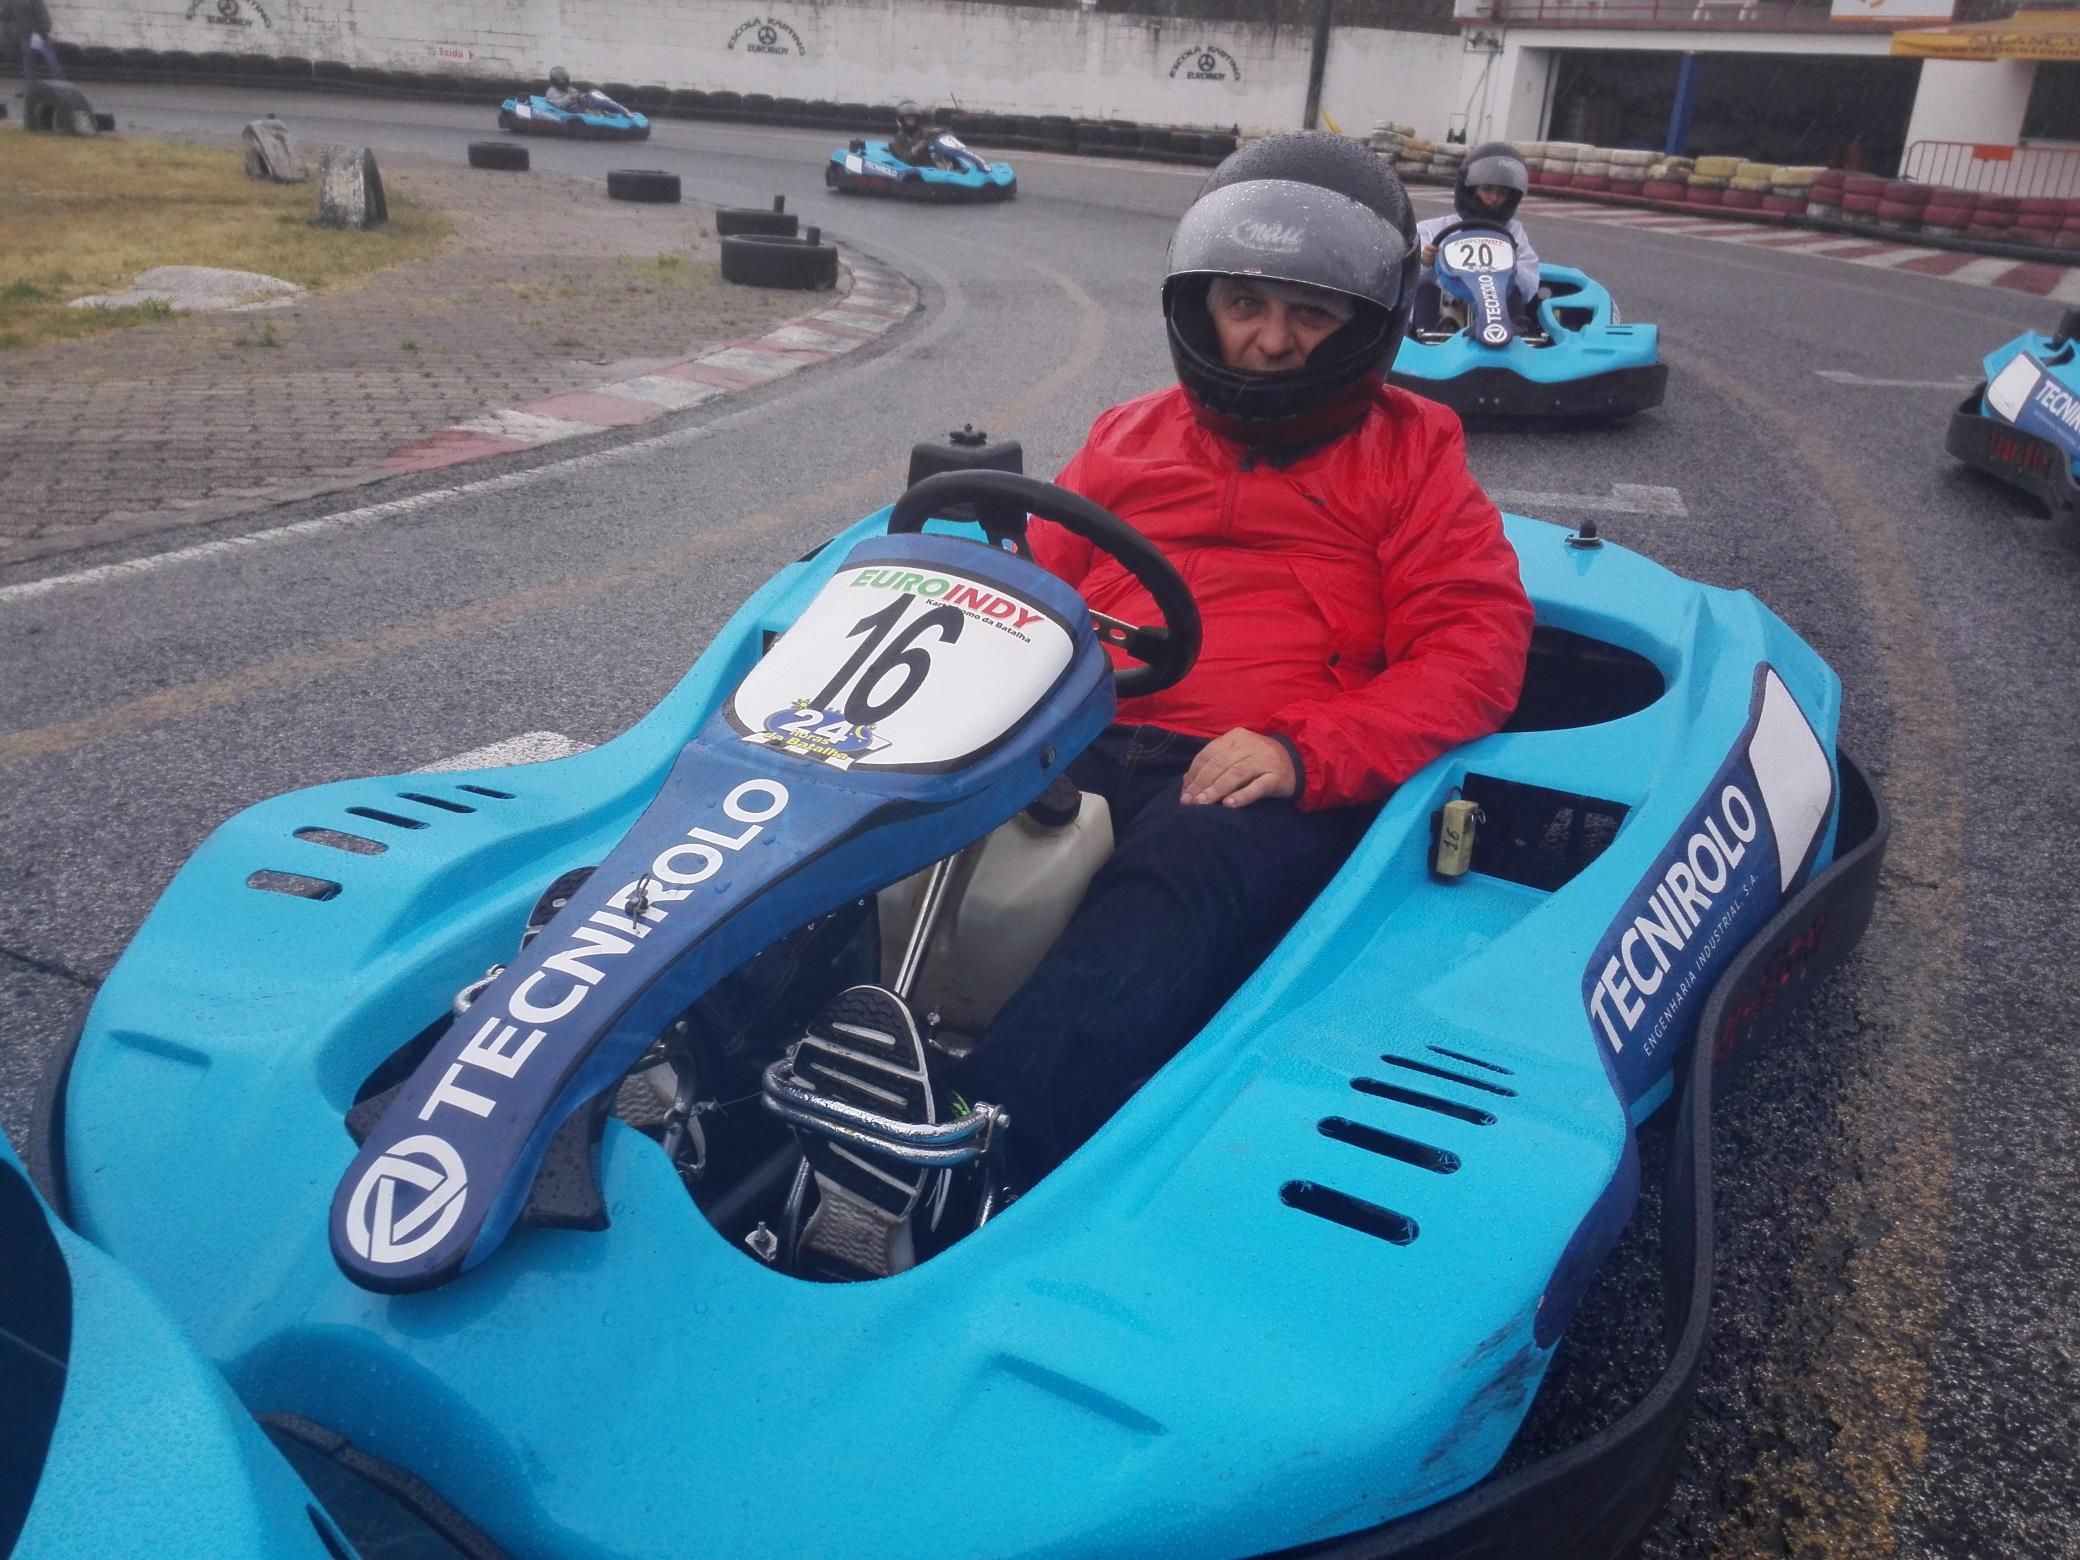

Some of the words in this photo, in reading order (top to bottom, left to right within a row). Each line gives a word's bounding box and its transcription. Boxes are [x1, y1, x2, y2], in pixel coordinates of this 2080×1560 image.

[728, 17, 761, 50] ESCOLA
[767, 17, 806, 56] KARTING
[747, 44, 789, 55] EUROINDY
[1169, 46, 1201, 78] ESCOLA
[1207, 45, 1241, 81] KARTING
[1460, 244, 1493, 268] 20
[849, 569, 1044, 629] EUROINDY
[981, 616, 994, 626] da
[995, 622, 1031, 644] Batalha
[809, 593, 965, 726] 16
[778, 709, 854, 744] 24
[789, 729, 830, 745] horas
[786, 737, 849, 761] Batalha
[1590, 785, 1756, 1054] TECNIROLO
[418, 778, 789, 1121] TECNIROLO
[1643, 972, 1697, 1056] ENGENHARIA
[1696, 900, 1744, 971] INDUSTRIAL,
